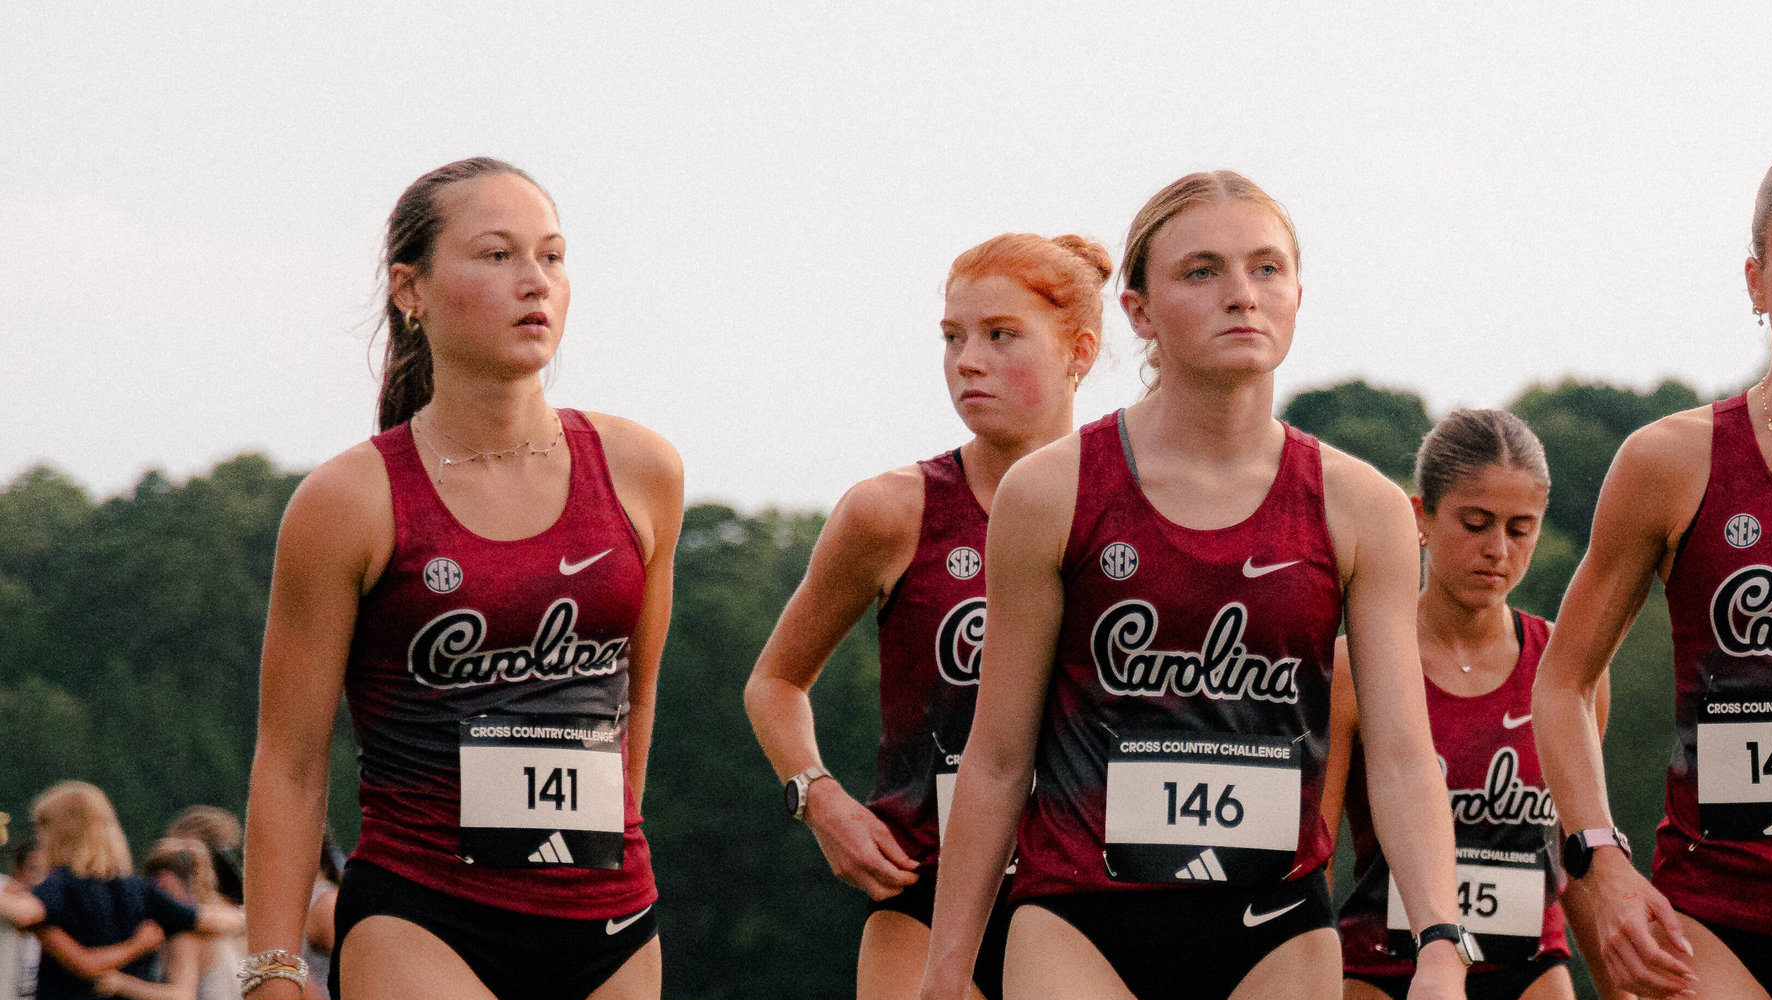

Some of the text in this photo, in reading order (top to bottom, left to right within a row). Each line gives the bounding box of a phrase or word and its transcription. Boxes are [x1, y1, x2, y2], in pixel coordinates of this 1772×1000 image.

[1727, 517, 1758, 546] SEC
[427, 562, 460, 590] SEC
[950, 552, 979, 576] SEC
[1104, 544, 1136, 577] SEC
[408, 598, 629, 688] Carolina
[1091, 599, 1301, 705] Carolina
[1707, 702, 1741, 714] CROSS
[470, 726, 614, 743] CROSS COUNTRY CHALLENGE
[1120, 741, 1290, 759] CROSS COUNTRY CHALLENGE
[523, 766, 578, 812] 141
[1447, 746, 1560, 826] rolina
[1164, 781, 1244, 829] 146
[1480, 849, 1536, 864] CHALLENGE
[1458, 881, 1498, 918] 45
